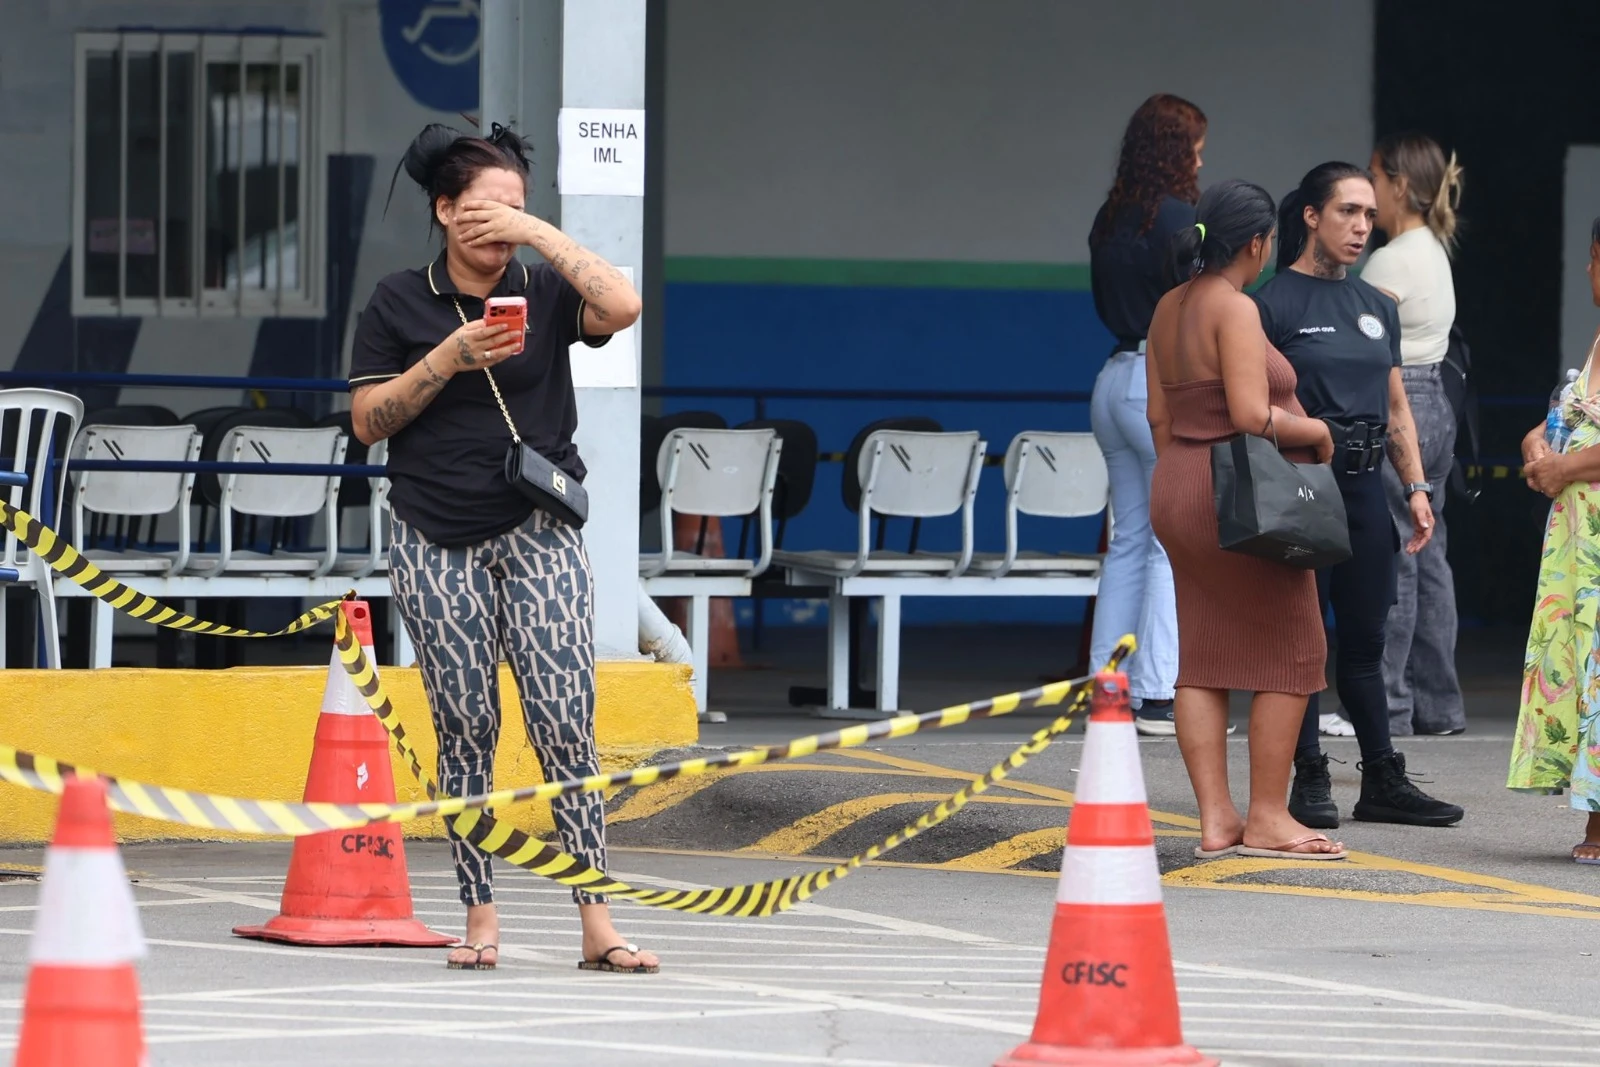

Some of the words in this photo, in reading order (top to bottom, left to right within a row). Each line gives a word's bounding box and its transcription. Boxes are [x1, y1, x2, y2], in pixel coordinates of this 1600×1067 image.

[578, 121, 638, 139] SENHA
[593, 146, 623, 163] IML
[1061, 960, 1129, 988] CFISC
